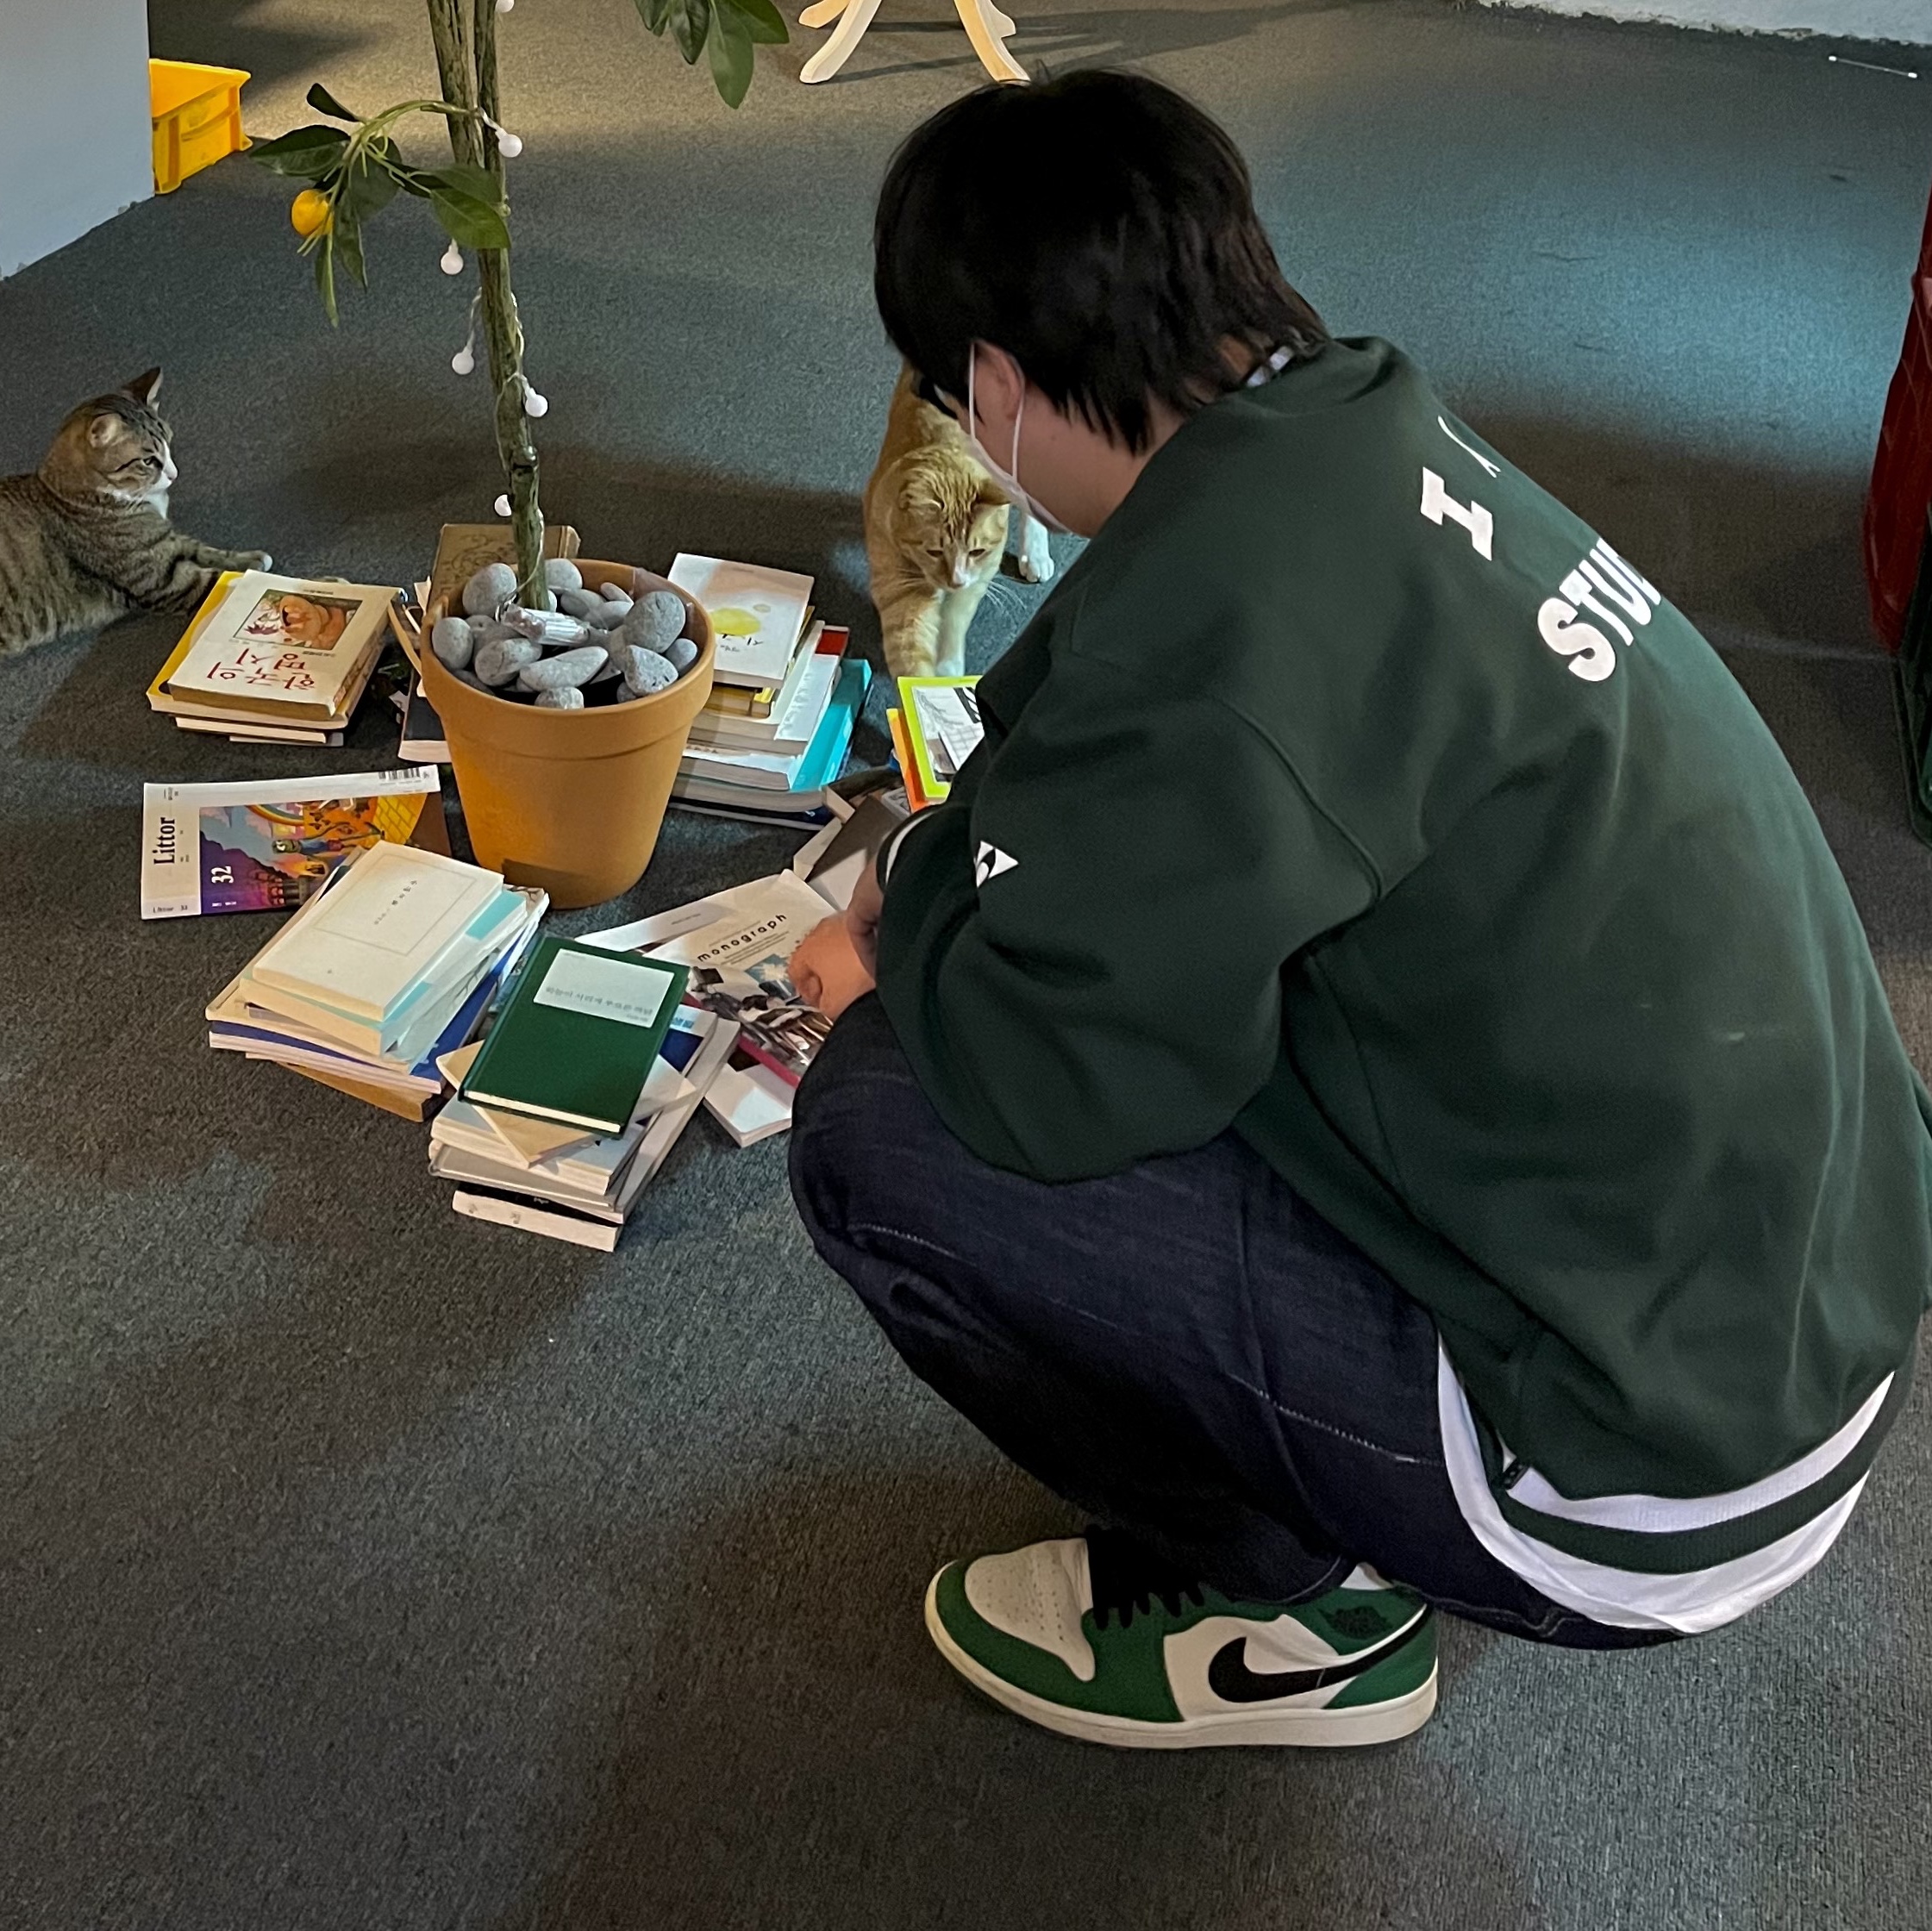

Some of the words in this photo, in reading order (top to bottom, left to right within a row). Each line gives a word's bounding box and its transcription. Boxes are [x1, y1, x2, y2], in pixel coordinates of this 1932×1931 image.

[235, 648, 306, 671] 명시
[207, 662, 315, 691] 한국의
[152, 816, 175, 865] Littor
[210, 866, 234, 884] 32
[697, 914, 786, 962] monograph
